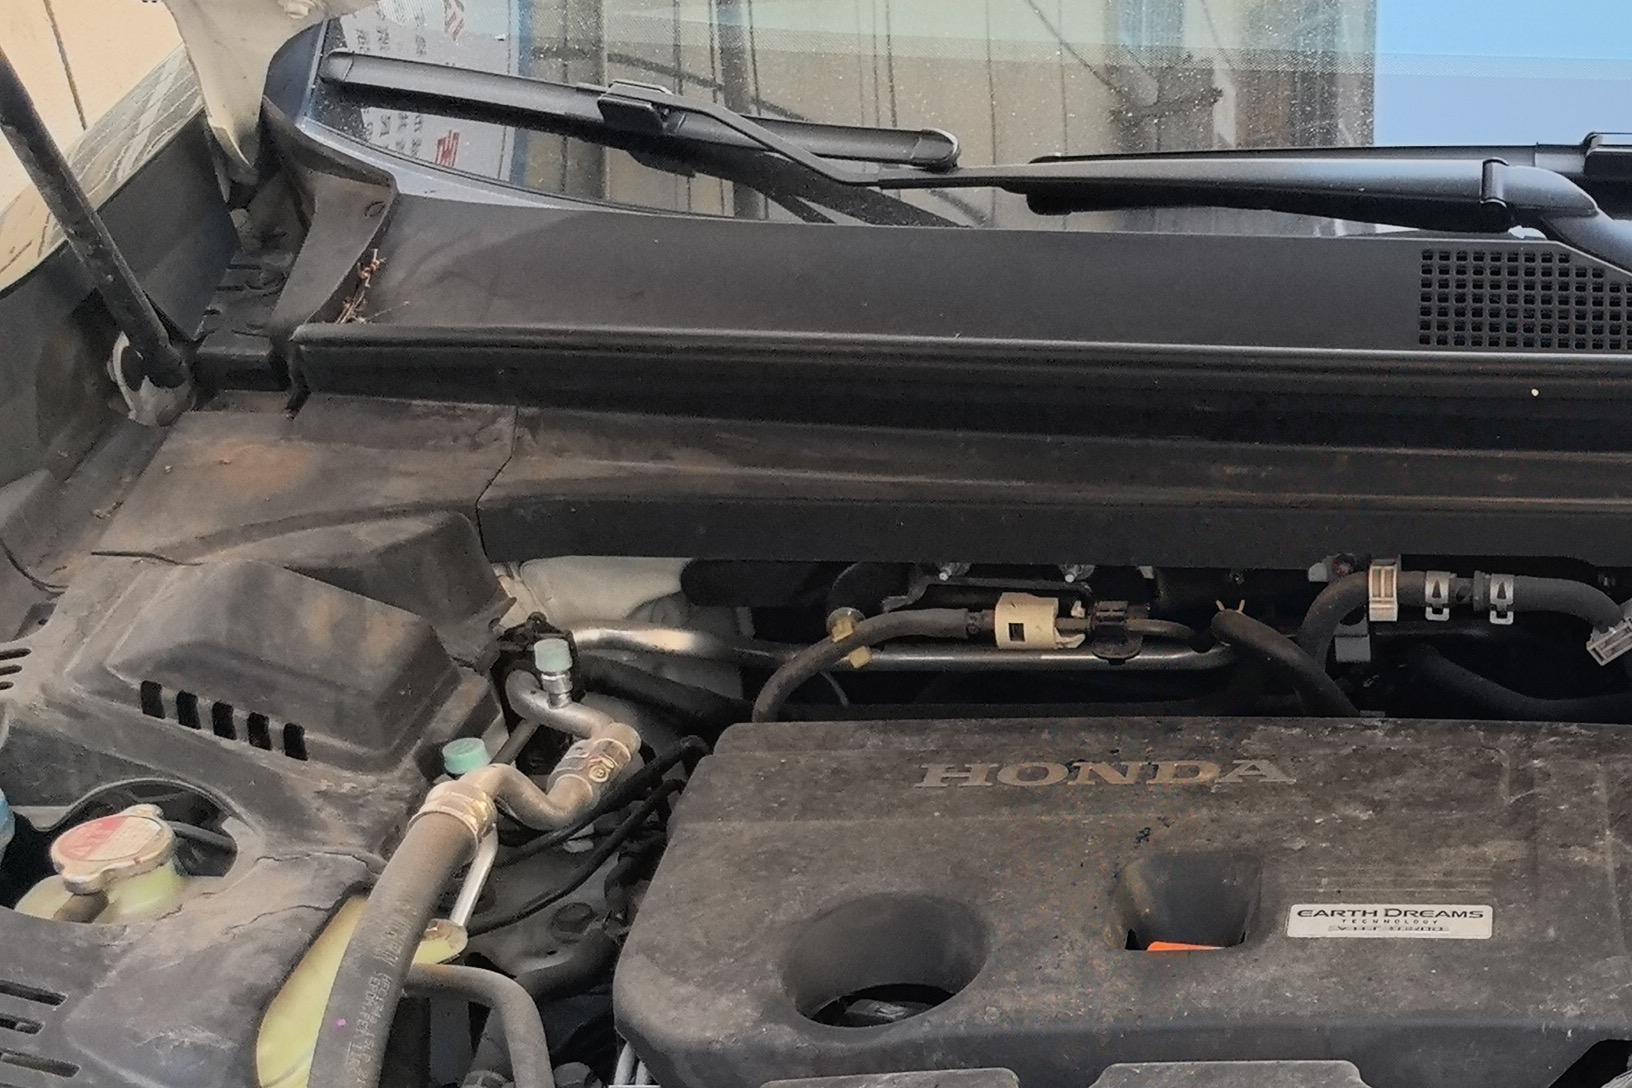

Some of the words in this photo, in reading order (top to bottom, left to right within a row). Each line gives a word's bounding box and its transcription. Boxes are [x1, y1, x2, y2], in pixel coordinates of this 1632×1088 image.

[913, 758, 1297, 788] HONDA
[1297, 909, 1378, 918] EARTH
[1383, 907, 1484, 919] DREAMS
